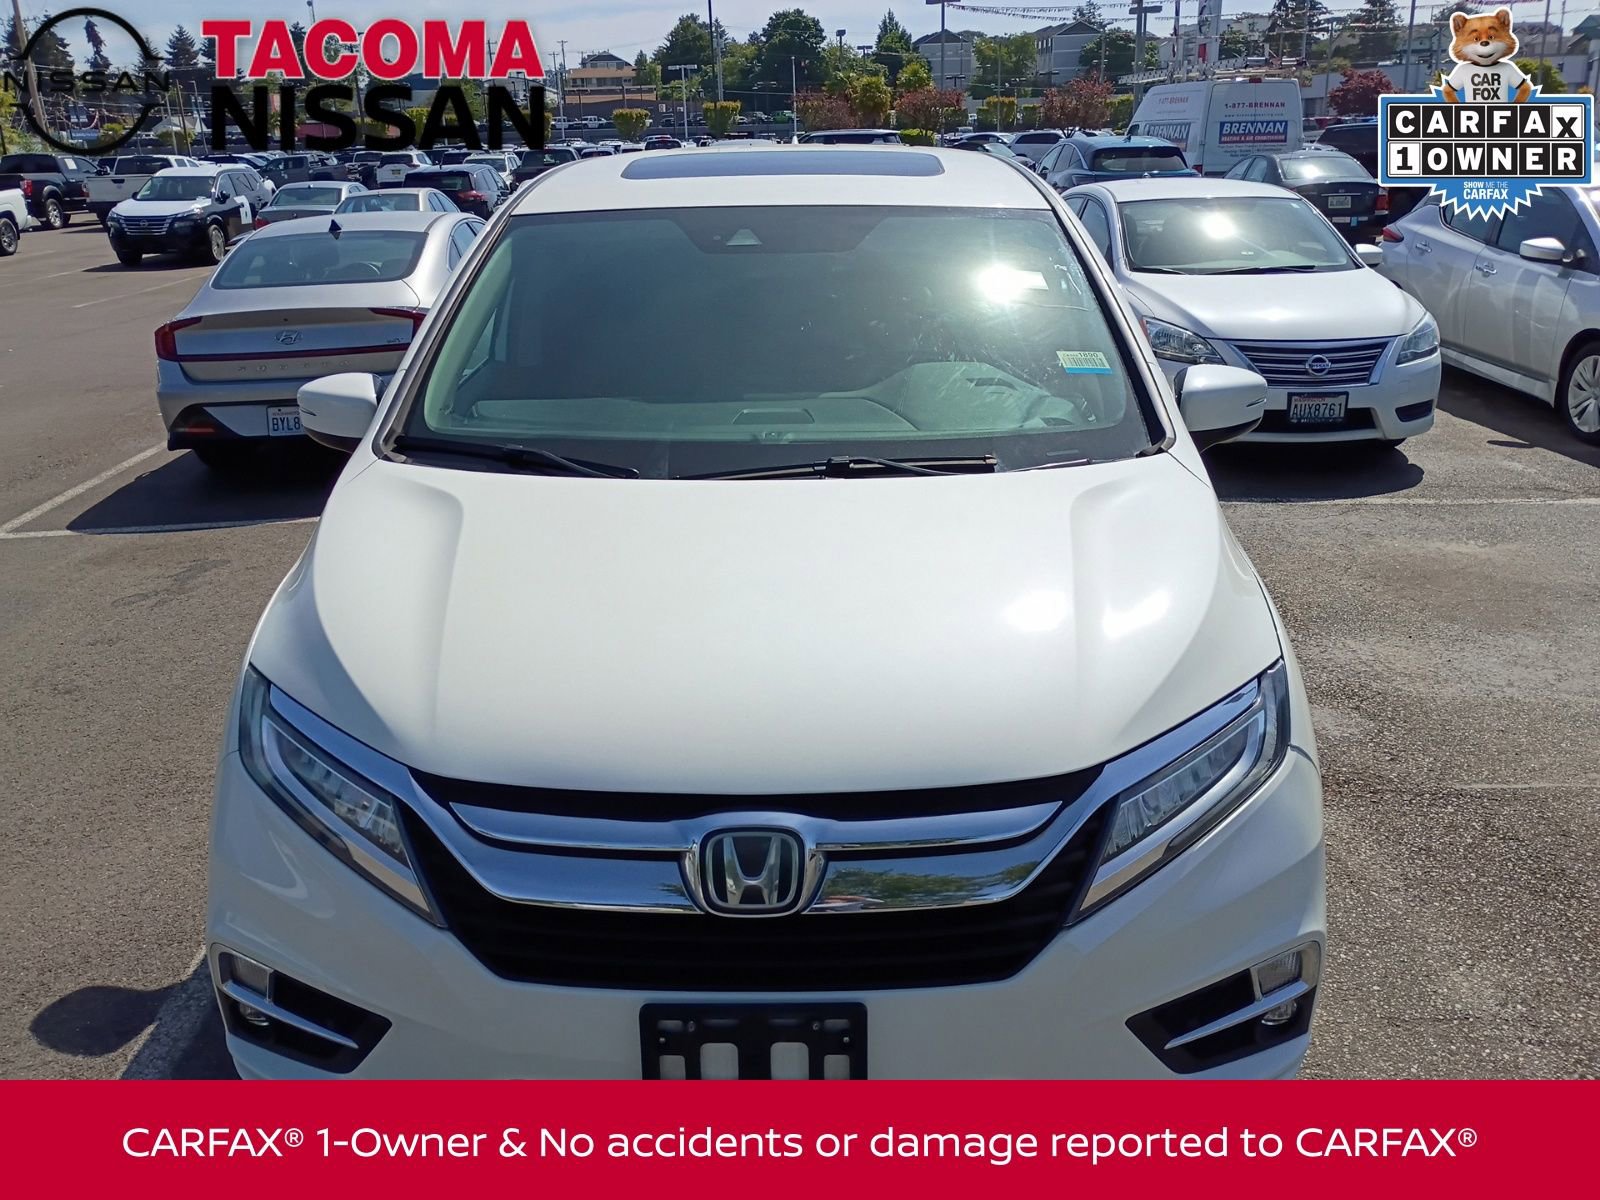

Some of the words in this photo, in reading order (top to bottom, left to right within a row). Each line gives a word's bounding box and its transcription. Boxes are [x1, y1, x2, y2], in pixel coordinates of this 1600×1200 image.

[1224, 101, 1286, 109] 1-877-BRENNAN
[1149, 124, 1189, 139] BRENNAN
[1222, 122, 1286, 134] BRENNAN
[1292, 403, 1342, 417] AUX8761
[272, 416, 303, 432] BYL8
